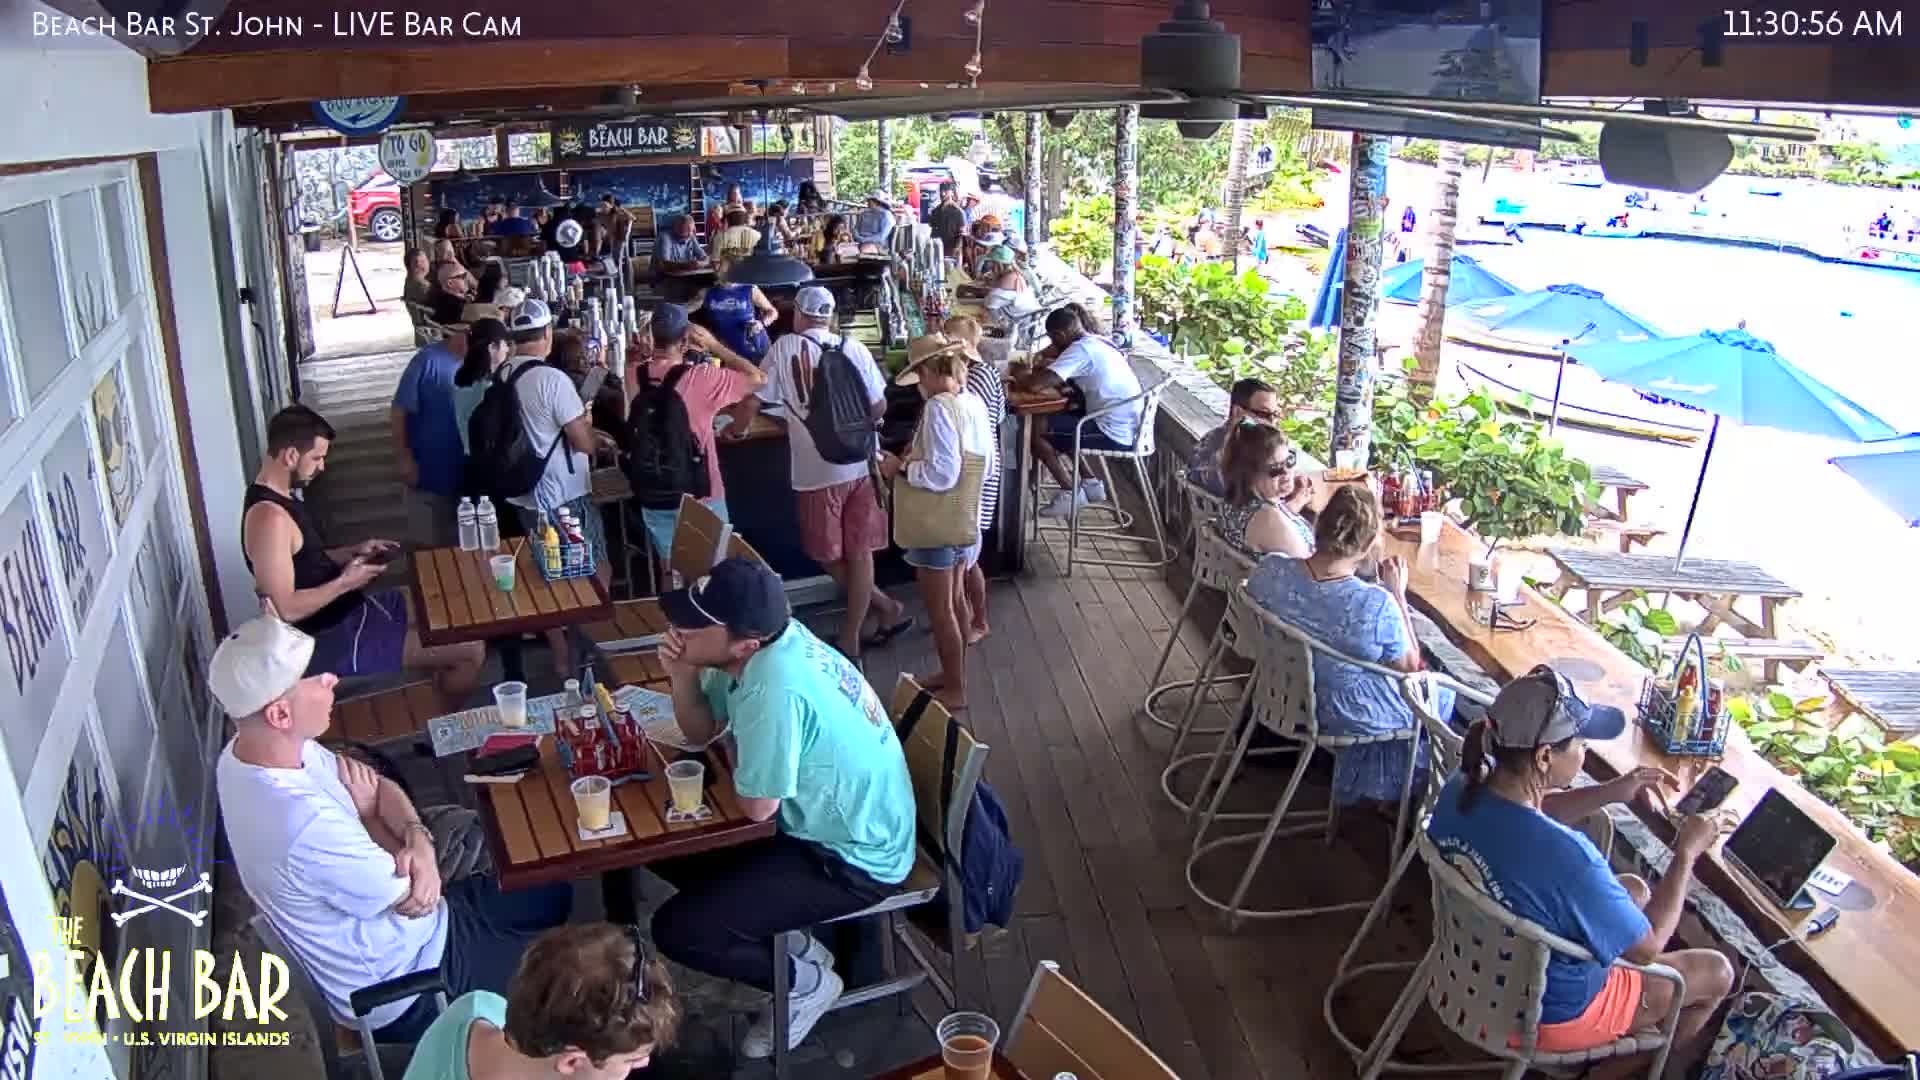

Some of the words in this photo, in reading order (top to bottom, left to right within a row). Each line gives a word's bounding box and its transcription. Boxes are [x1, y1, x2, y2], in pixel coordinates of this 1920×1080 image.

[386, 135, 404, 155] TO
[409, 133, 426, 152] GO
[589, 128, 633, 148] BEACH
[638, 127, 669, 145] BAR
